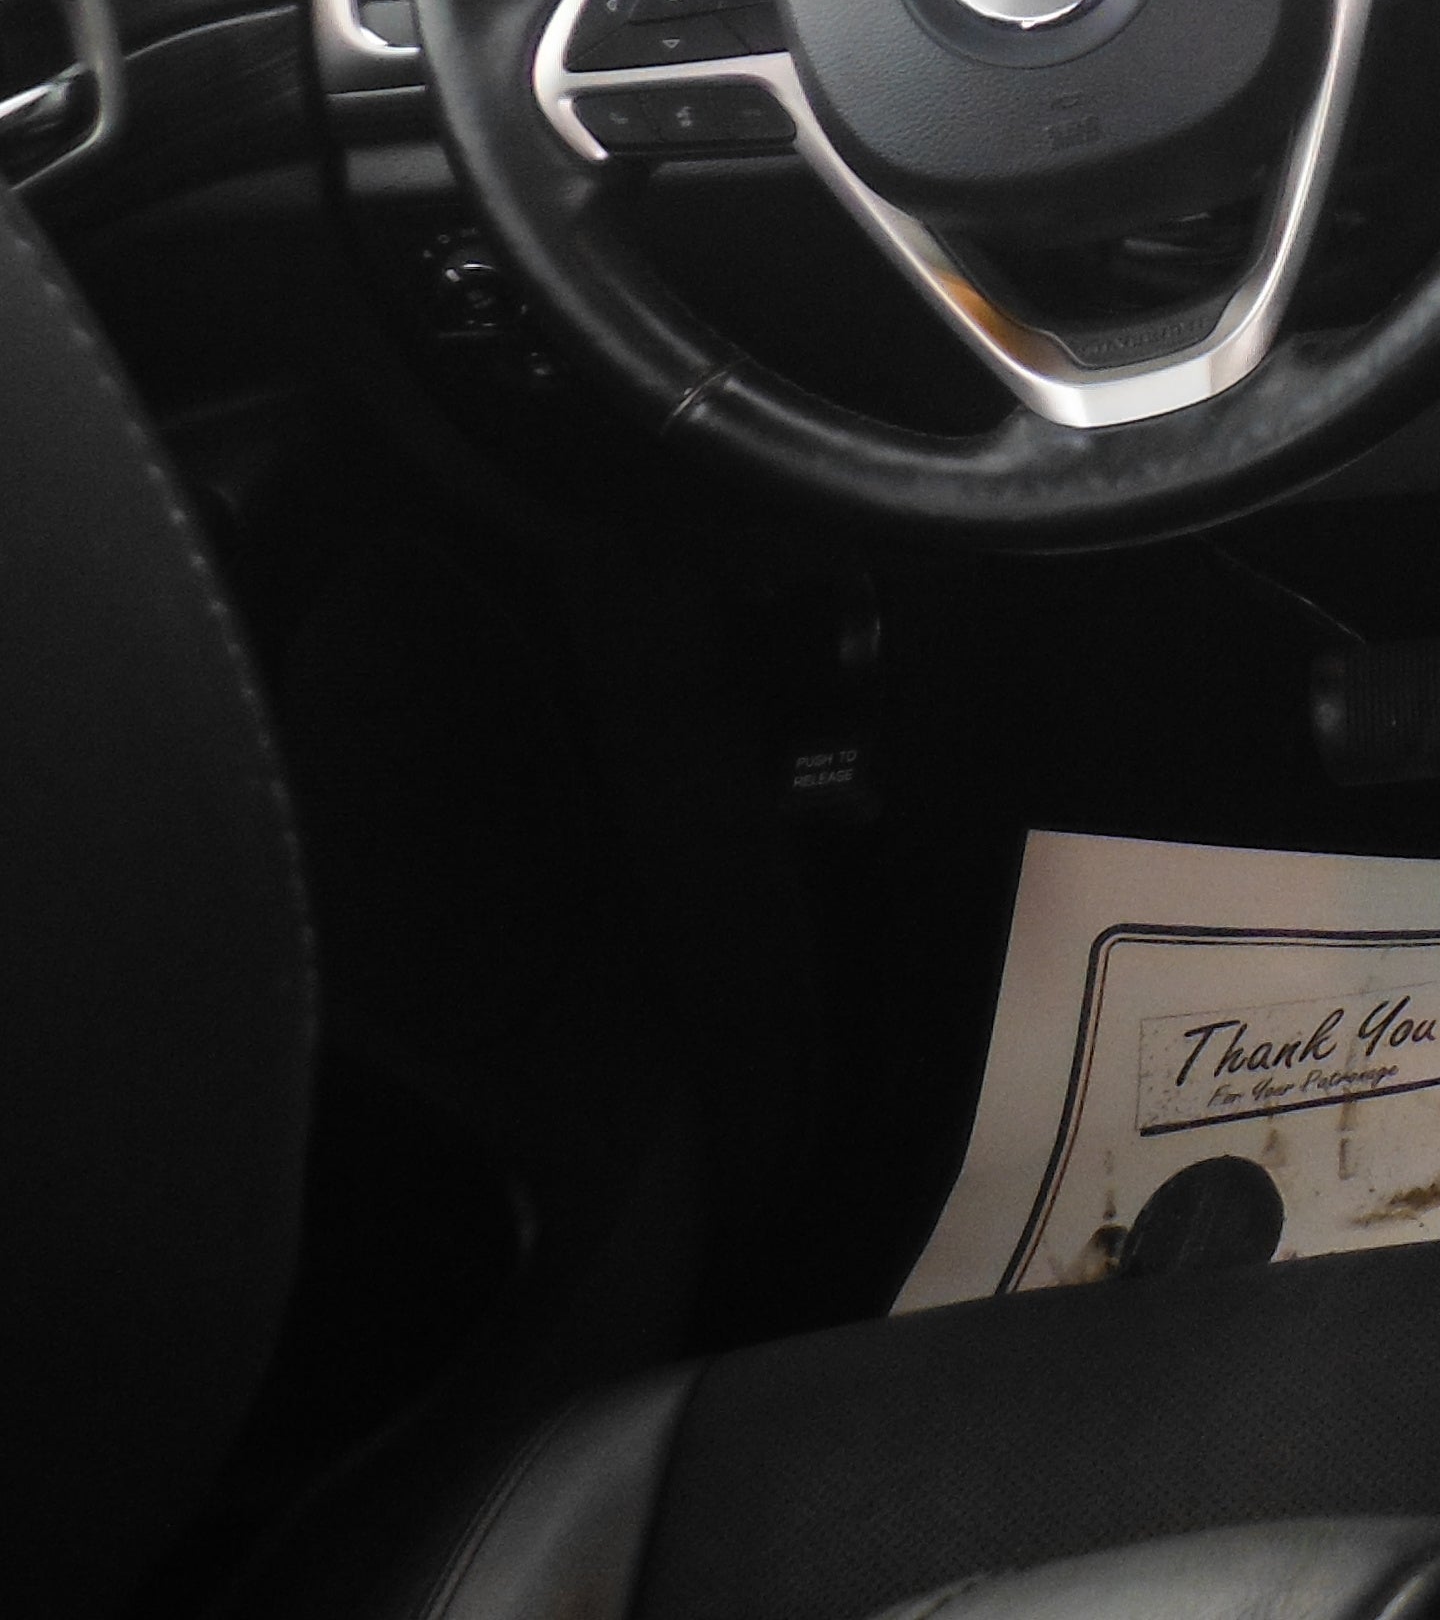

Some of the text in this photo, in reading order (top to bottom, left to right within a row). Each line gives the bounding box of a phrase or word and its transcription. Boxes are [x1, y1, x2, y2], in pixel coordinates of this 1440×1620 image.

[839, 749, 857, 764] TO
[1175, 995, 1437, 1087] Thank You
[1206, 1064, 1400, 1108] For Your Patronage
